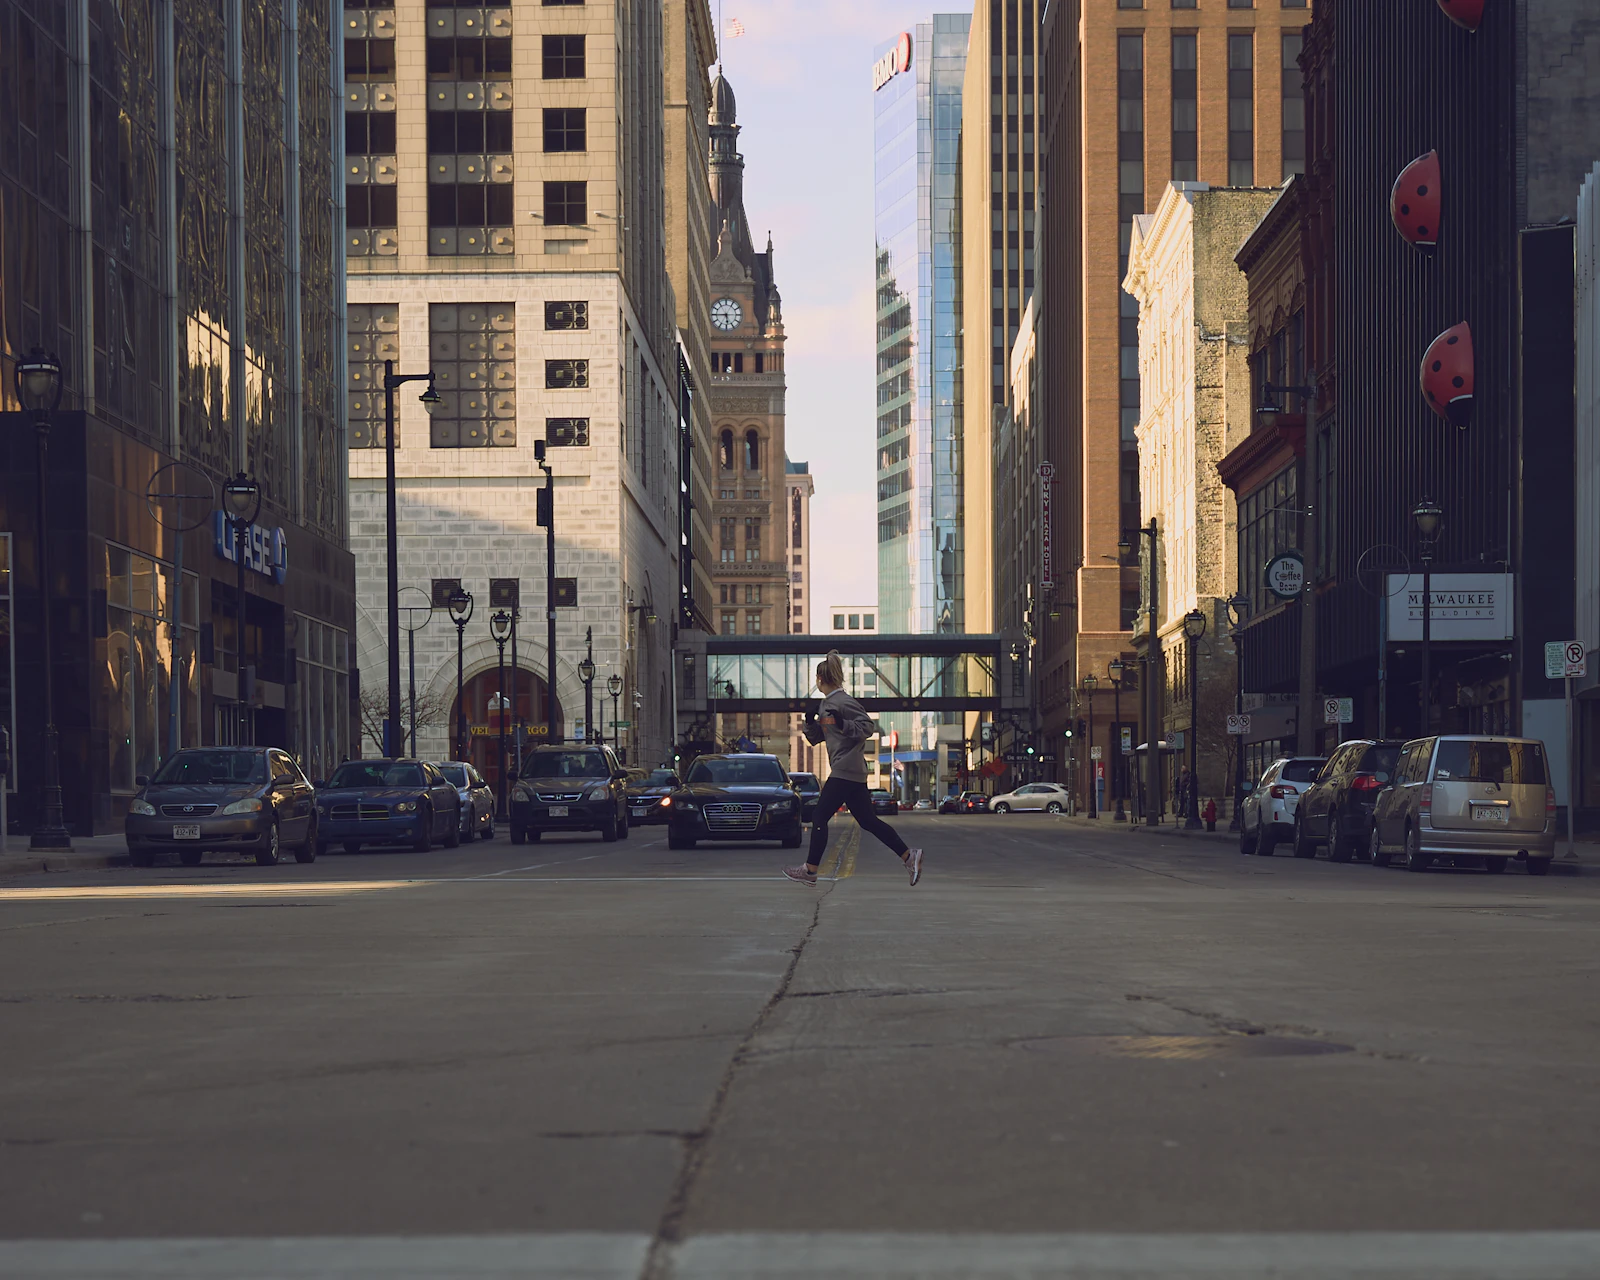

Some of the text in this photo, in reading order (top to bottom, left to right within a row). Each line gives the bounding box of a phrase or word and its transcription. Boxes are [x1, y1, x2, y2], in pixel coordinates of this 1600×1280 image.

[872, 46, 898, 92] BMO
[1042, 466, 1051, 507] DRURY
[1281, 561, 1294, 571] The
[1275, 571, 1301, 581] Coffee
[1279, 582, 1297, 591] Bean
[1408, 594, 1495, 605] MILWAUKEE
